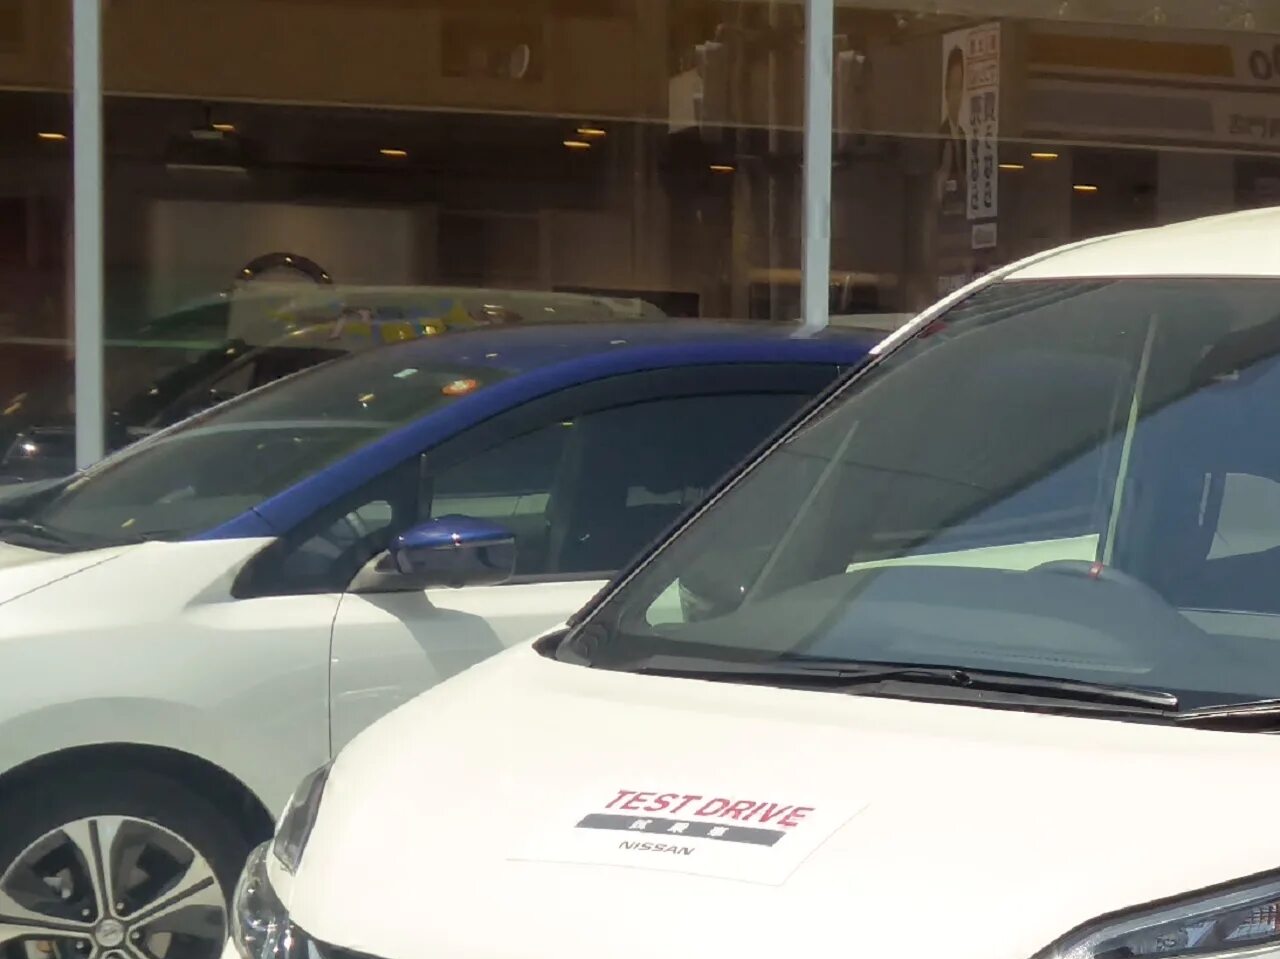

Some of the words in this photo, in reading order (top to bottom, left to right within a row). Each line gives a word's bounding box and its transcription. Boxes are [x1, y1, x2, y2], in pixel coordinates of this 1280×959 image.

[604, 789, 703, 815] TEST
[694, 797, 816, 827] DRIVE
[618, 840, 695, 856] NISSAN
